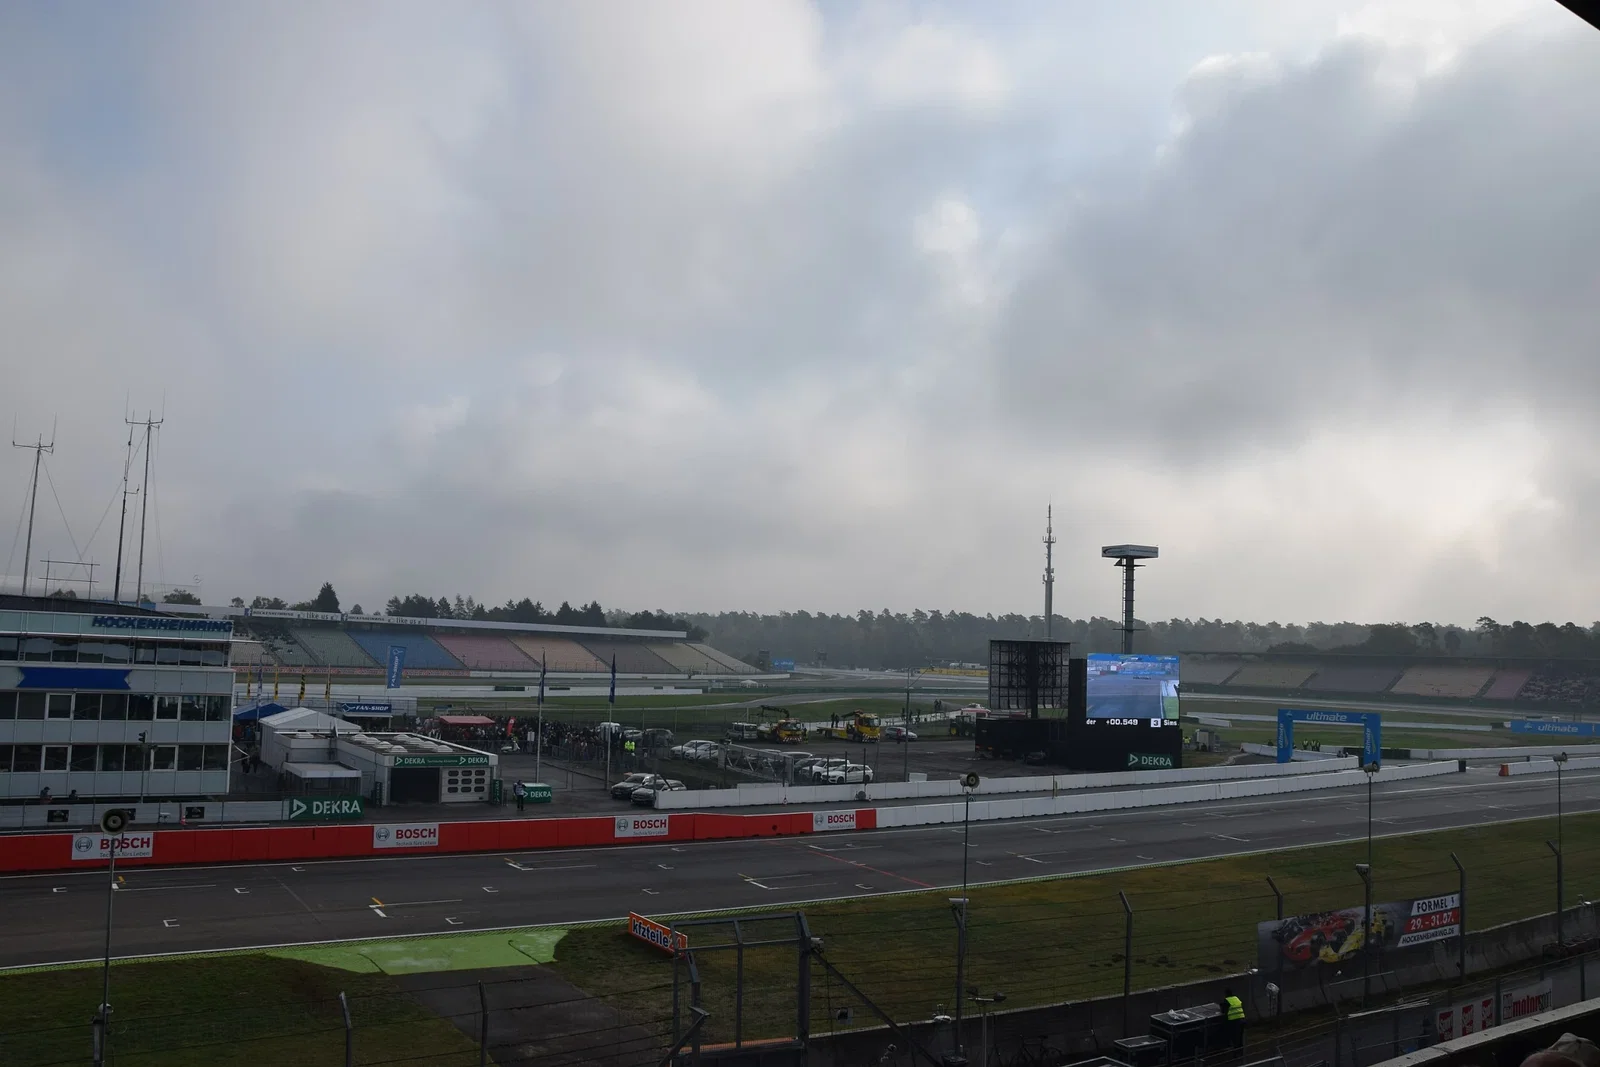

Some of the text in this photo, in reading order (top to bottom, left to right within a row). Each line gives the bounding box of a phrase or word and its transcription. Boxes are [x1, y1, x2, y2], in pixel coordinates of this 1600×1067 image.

[307, 611, 319, 620] like
[396, 616, 408, 624] like
[92, 615, 233, 632] HOCKENHEIMRING
[1306, 712, 1347, 722] ultimate
[1538, 723, 1579, 733] ultimate
[404, 757, 426, 765] DEKRA
[1141, 756, 1172, 766] DEKRA
[312, 800, 362, 815] DEKRA
[633, 819, 667, 829] BOSCH
[828, 814, 855, 824] BOSCH
[396, 828, 437, 839] BOSCH
[101, 837, 150, 850] BOSCH
[1417, 898, 1447, 913] FORMEL
[1402, 928, 1454, 944] HOCKENHEIMRING.DE
